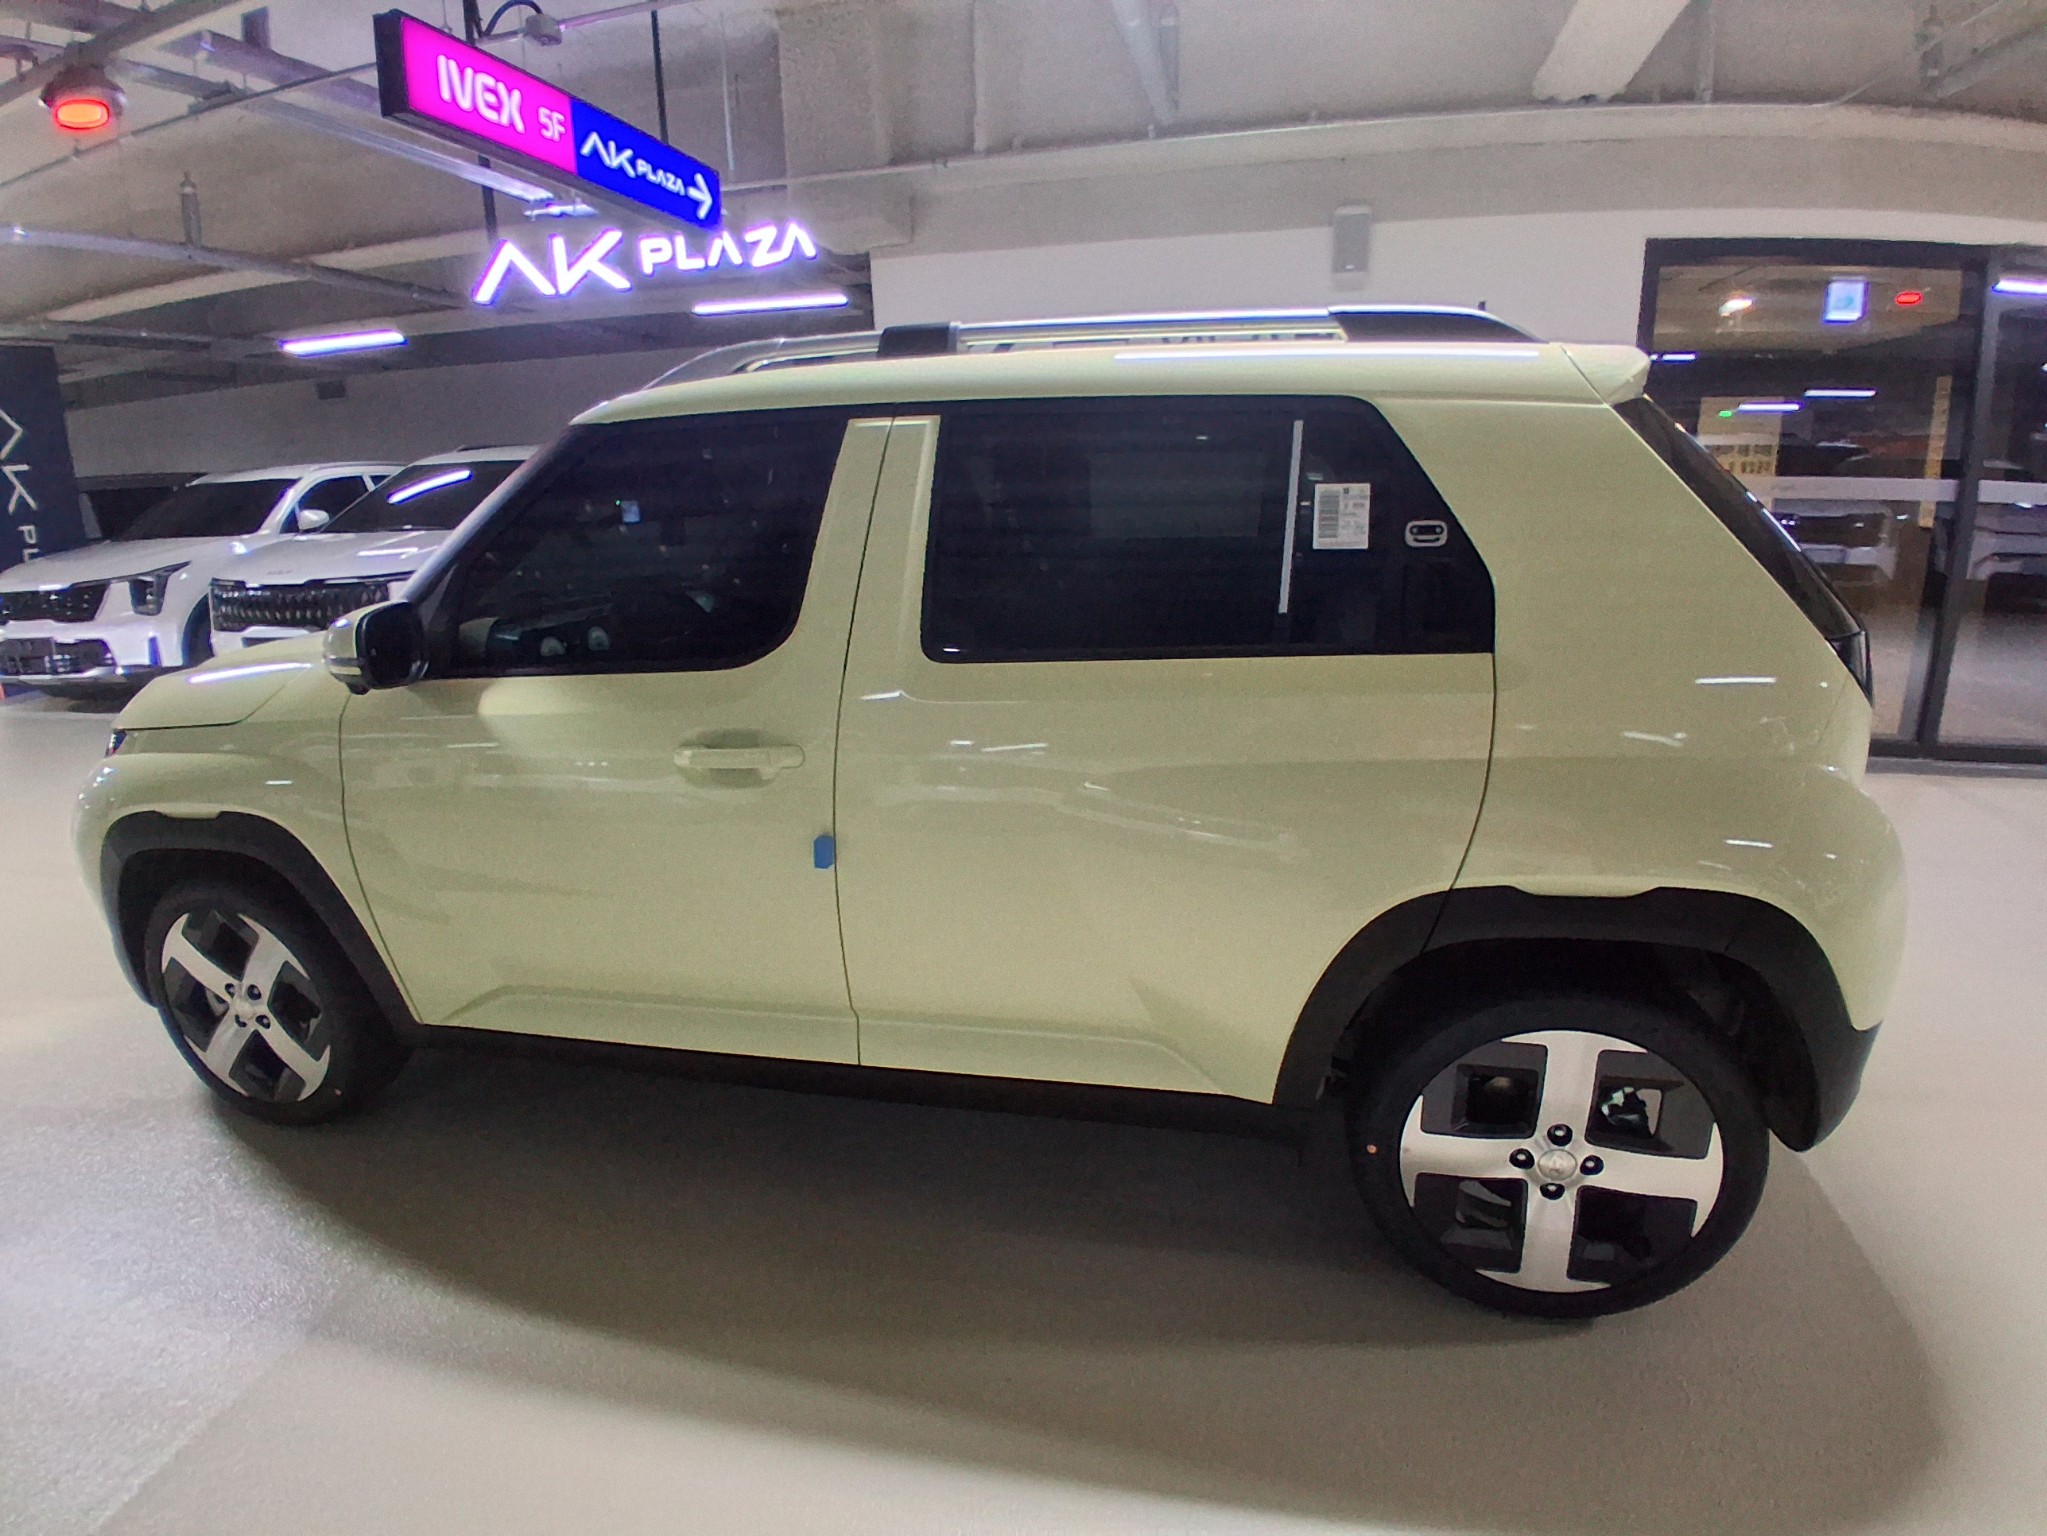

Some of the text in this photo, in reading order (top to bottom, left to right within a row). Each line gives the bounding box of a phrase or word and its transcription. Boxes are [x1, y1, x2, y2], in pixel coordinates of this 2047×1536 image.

[538, 106, 566, 142] 5F
[580, 131, 685, 196] AK PLAZA
[473, 222, 818, 305] AK PLAZA
